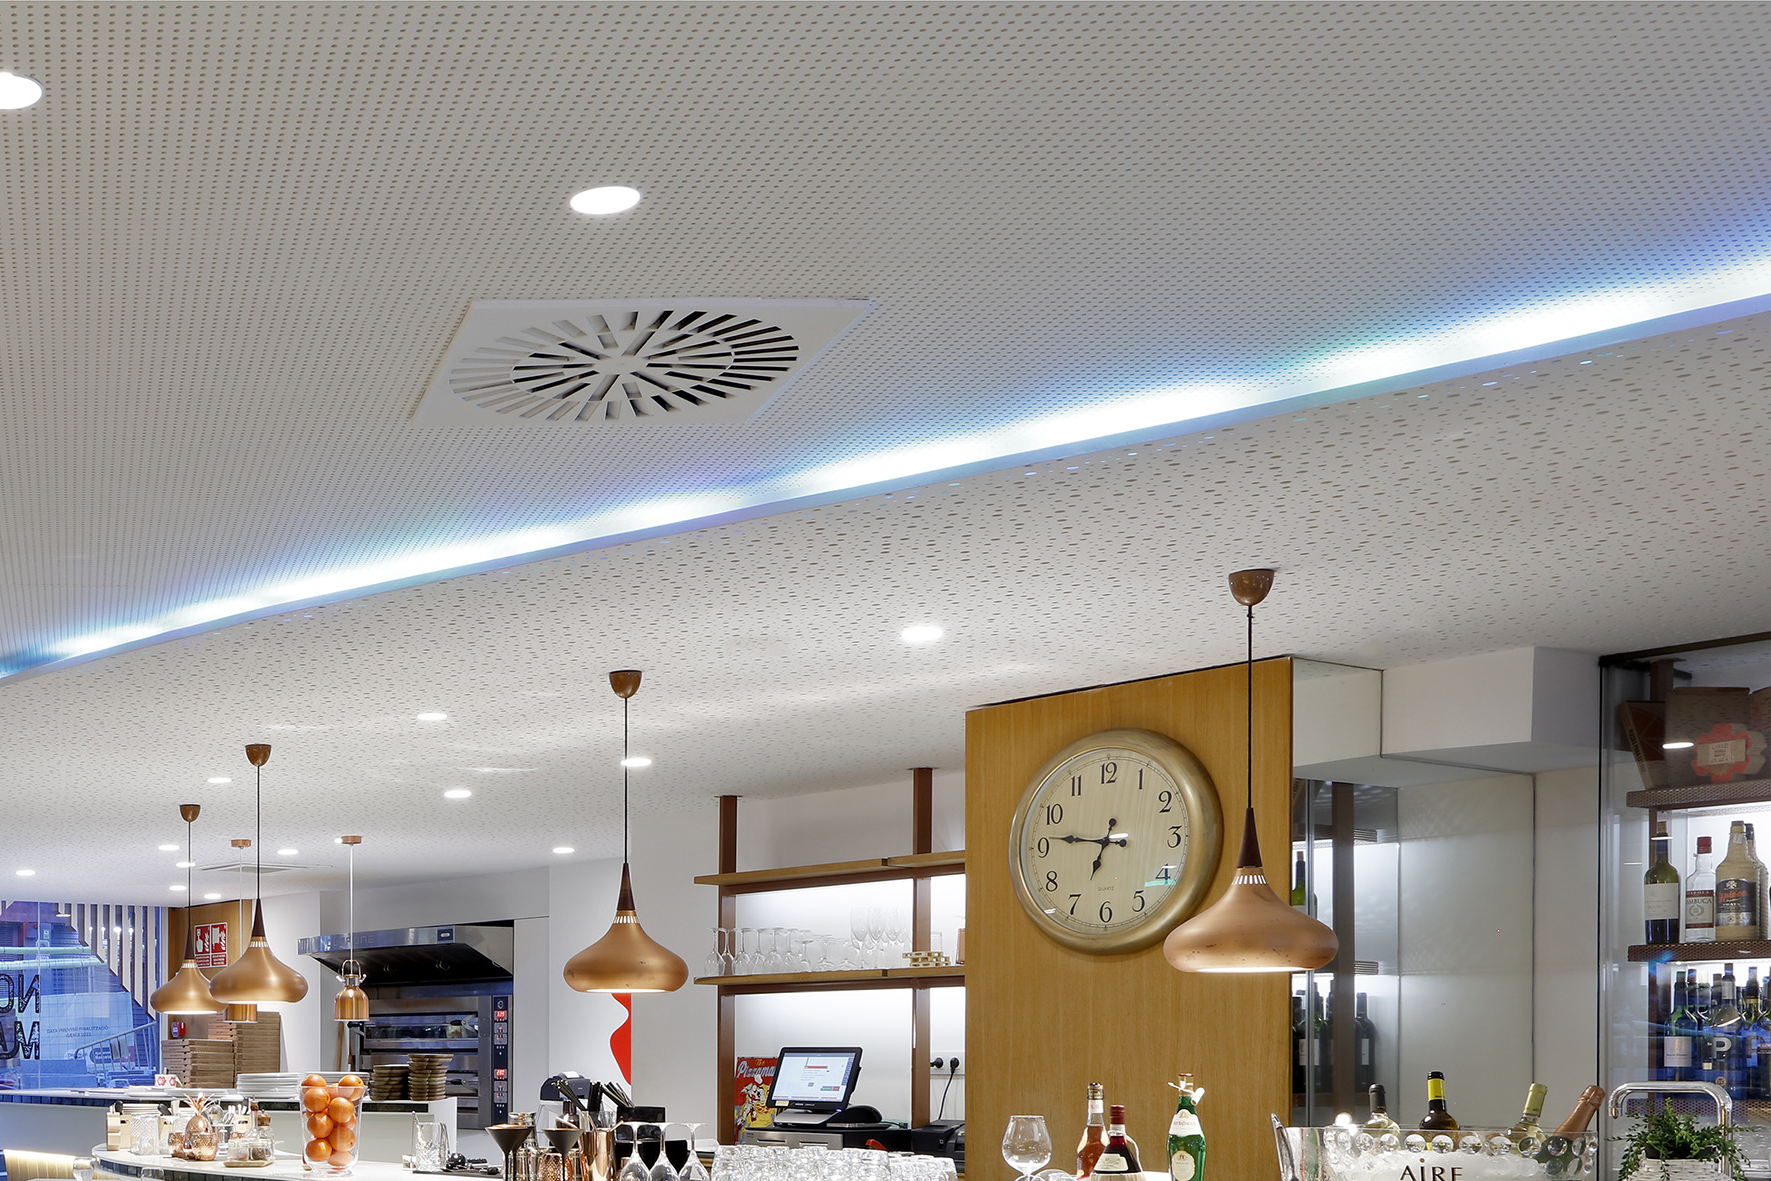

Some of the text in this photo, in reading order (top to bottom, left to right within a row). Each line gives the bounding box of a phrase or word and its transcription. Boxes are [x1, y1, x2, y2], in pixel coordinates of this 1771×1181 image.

[1100, 761, 1118, 784] 12
[1138, 768, 1143, 790] 1
[1071, 775, 1082, 796] 11
[1158, 790, 1172, 814] 2
[1046, 803, 1064, 825] 10
[1037, 837, 1050, 858] 9
[1167, 826, 1182, 848] 3
[1045, 870, 1058, 892] 8
[1155, 863, 1171, 885] 4
[1068, 893, 1081, 915] 7
[1131, 889, 1146, 912] 5
[1099, 901, 1113, 923] 6
